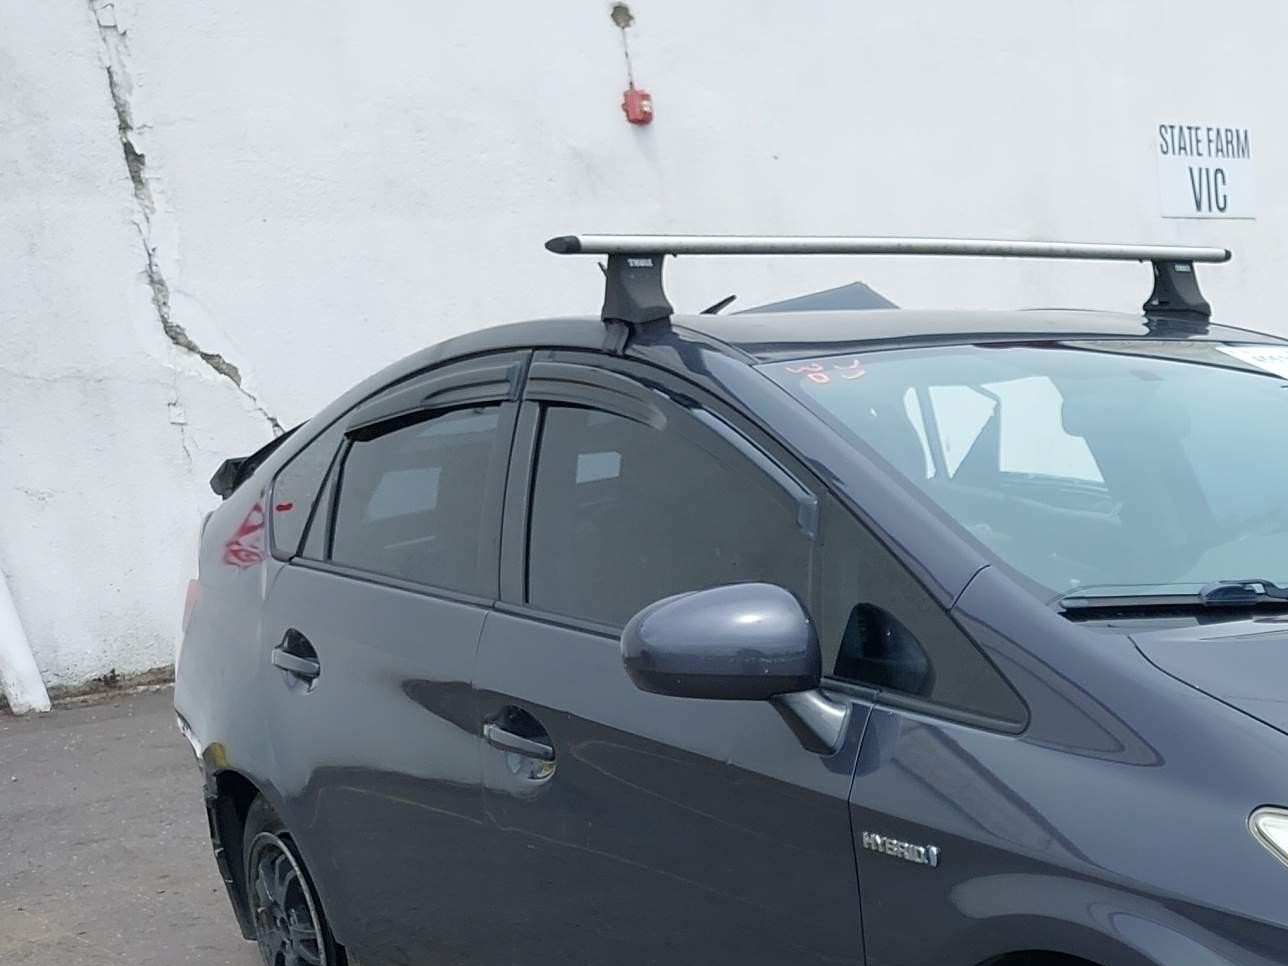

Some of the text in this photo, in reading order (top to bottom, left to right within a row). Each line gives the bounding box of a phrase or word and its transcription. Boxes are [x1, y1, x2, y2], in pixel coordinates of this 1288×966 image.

[1158, 124, 1250, 159] STATE FARM
[1188, 166, 1228, 213] VIC
[862, 831, 925, 864] HYBRID
